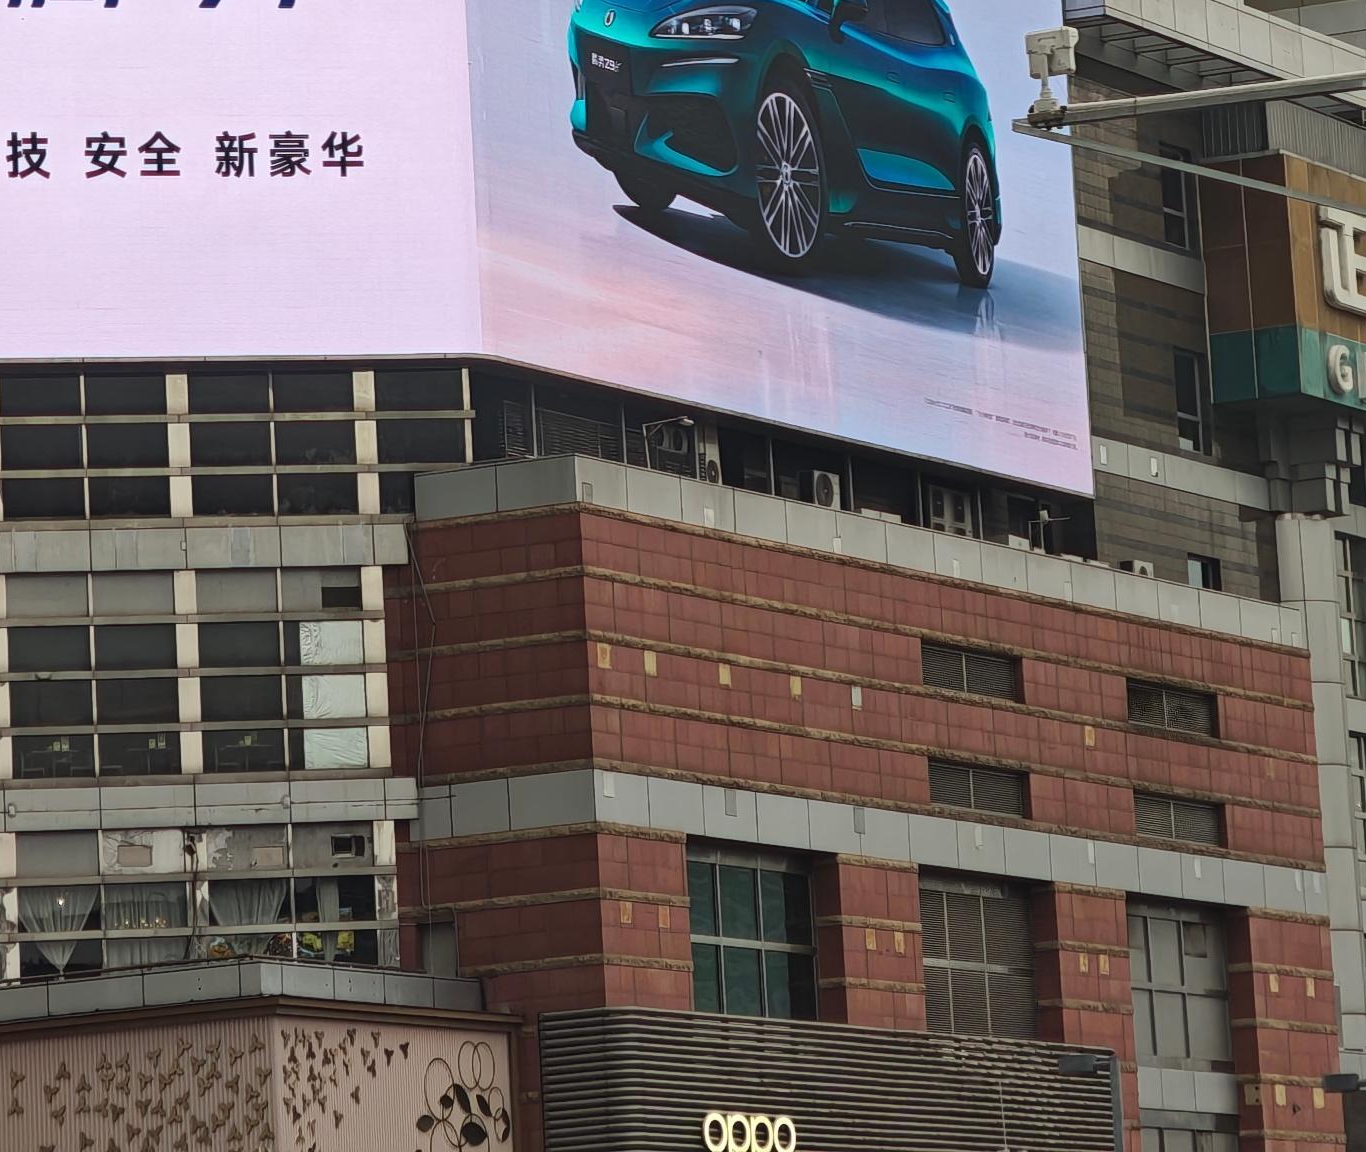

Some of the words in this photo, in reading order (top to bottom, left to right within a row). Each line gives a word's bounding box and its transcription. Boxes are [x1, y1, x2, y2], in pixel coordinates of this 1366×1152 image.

[84, 131, 181, 179] 安全
[214, 131, 364, 179] 新豪华
